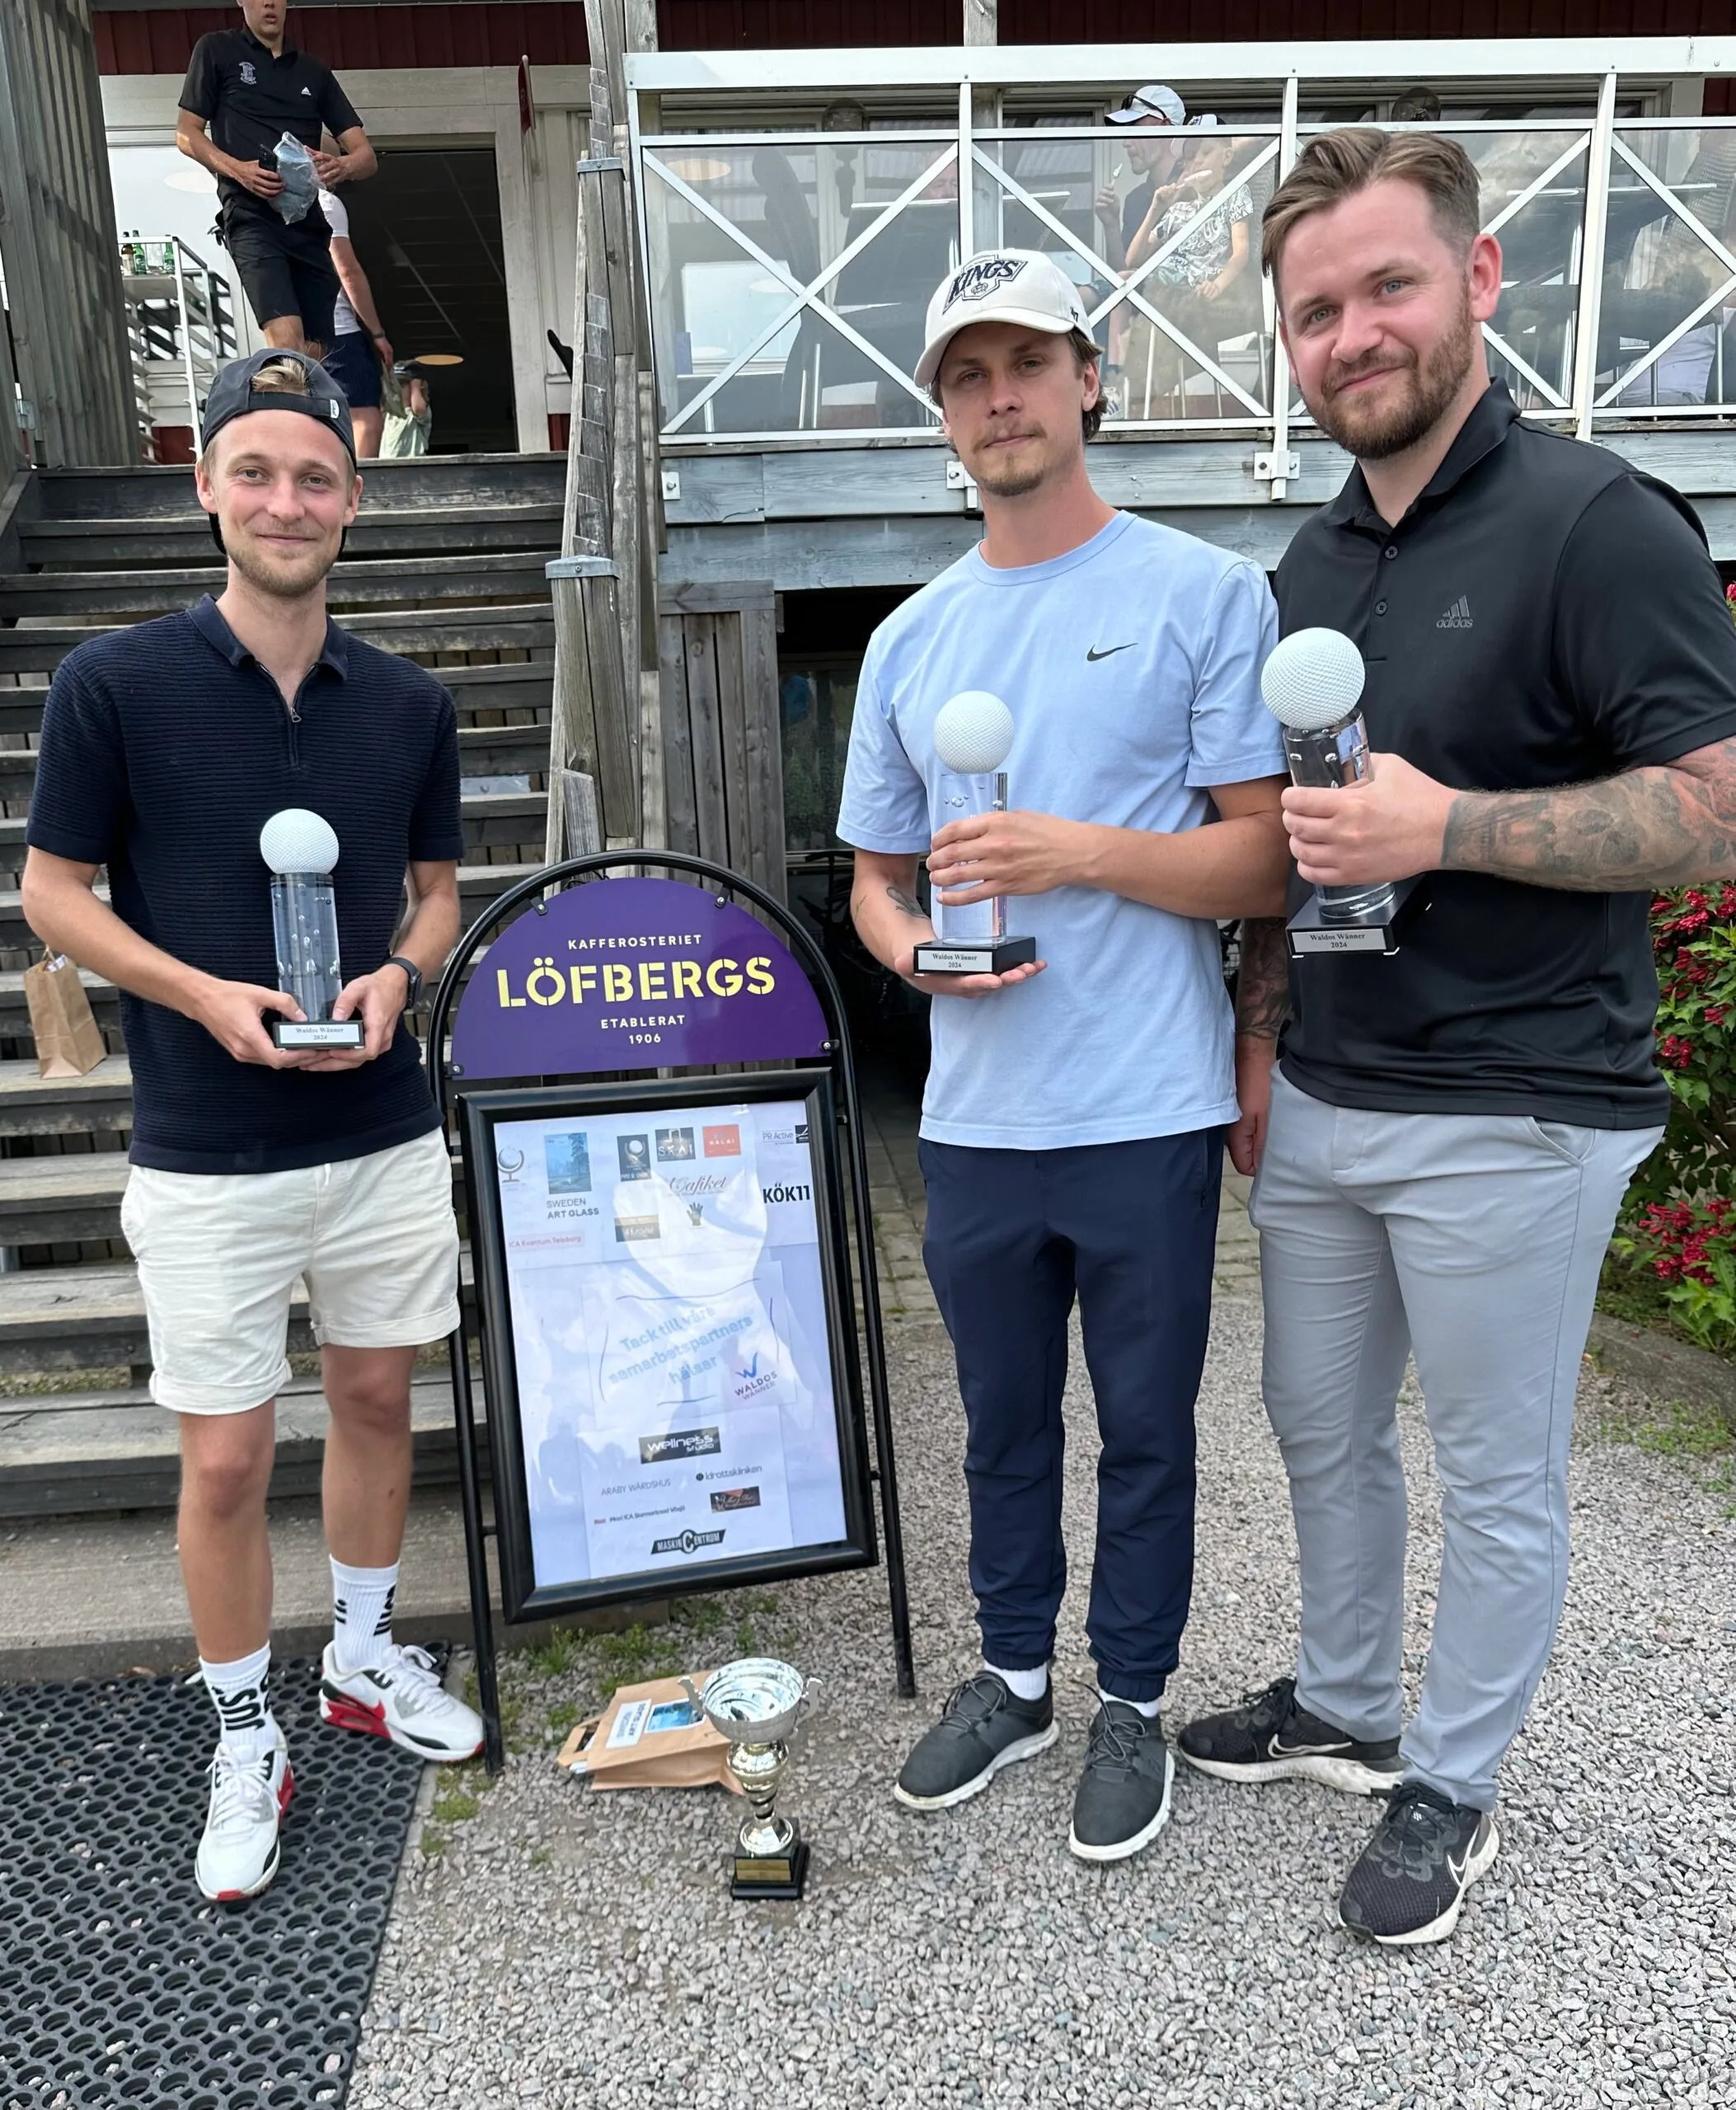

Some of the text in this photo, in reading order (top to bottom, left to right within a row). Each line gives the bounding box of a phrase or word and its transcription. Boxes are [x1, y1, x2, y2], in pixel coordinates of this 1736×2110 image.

[948, 260, 1019, 303] KINGS
[1436, 615, 1474, 628] adidas
[568, 934, 702, 950] KAFFEROSTERIET
[1310, 933, 1335, 941] Waldos
[496, 956, 776, 1008] LÖFBERGS
[601, 1015, 685, 1029] ETABLERAT
[628, 1034, 662, 1045] 1906
[762, 1132, 772, 1141] PR
[762, 1181, 810, 1204] KÖK11
[546, 1198, 586, 1209] SWEDEN
[547, 1207, 600, 1220] ART GLASS
[509, 1236, 582, 1248] ICA Kvantum Teleborg
[619, 1306, 716, 1352] Tack till våra
[669, 1356, 717, 1385] hälsar
[734, 1371, 778, 1397] WALDOS
[647, 1435, 714, 1452] wellness
[686, 1443, 715, 1453] studio
[601, 1484, 626, 1497] ARABY
